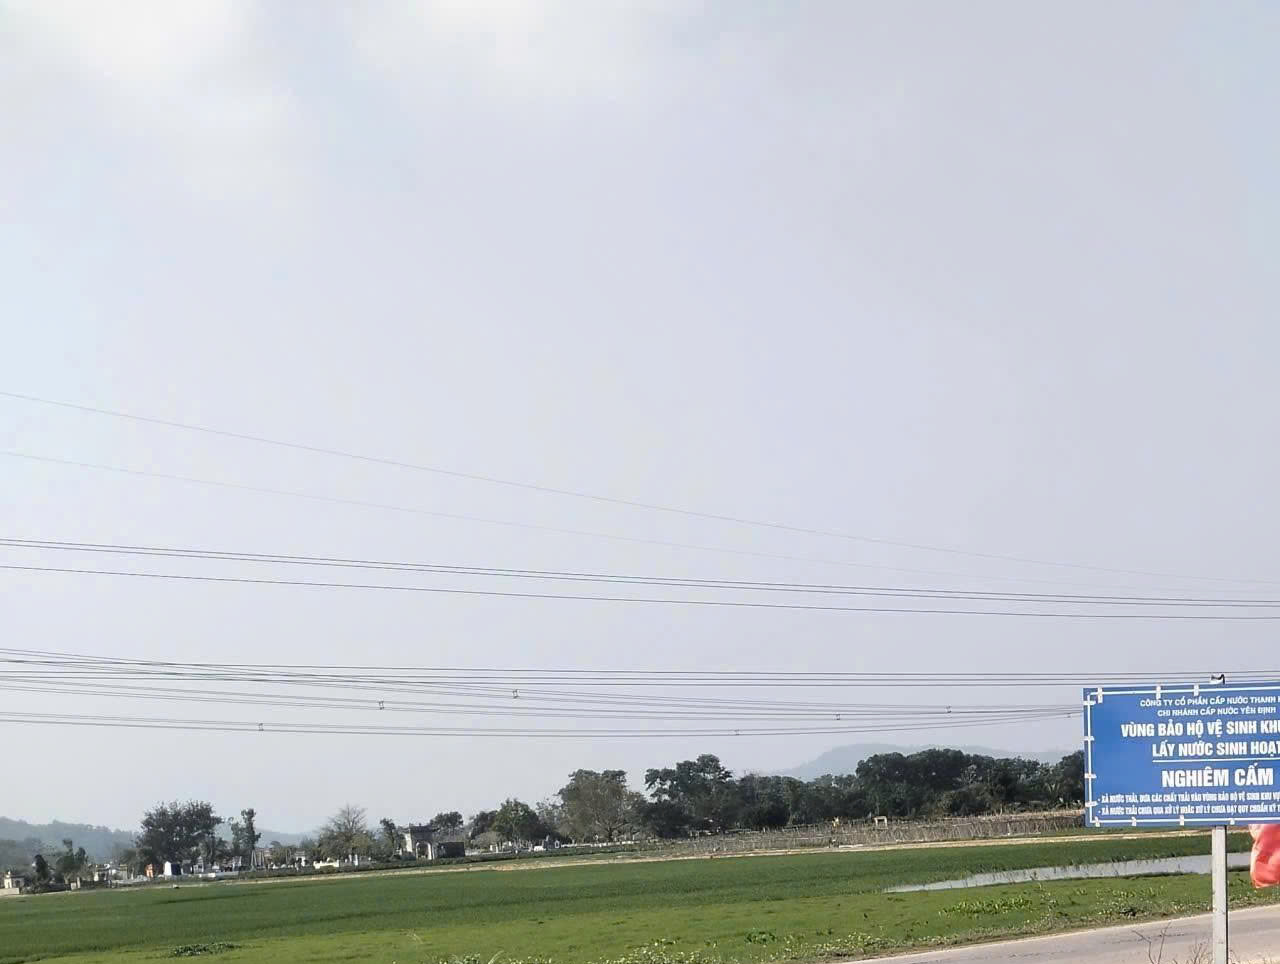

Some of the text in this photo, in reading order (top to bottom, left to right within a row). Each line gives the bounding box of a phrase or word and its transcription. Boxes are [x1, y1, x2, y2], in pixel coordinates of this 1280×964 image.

[1140, 699, 1161, 707] CÔNG
[1210, 696, 1225, 705] CẤP
[1227, 696, 1248, 704] NƯỚC
[1172, 708, 1198, 716] NHÁNH
[1200, 706, 1215, 715] CẤP
[1217, 706, 1238, 715] NƯỚC
[1240, 706, 1255, 714] YÊN
[1258, 707, 1276, 715] ĐỊNH
[1121, 722, 1154, 737] VÙNG
[1158, 719, 1183, 736] BẢO
[1187, 720, 1204, 738] HỘ
[1207, 720, 1222, 738] VỆ
[1227, 720, 1256, 734] SINH
[1152, 740, 1175, 757] LẤY
[1178, 740, 1213, 756] NƯỚC
[1217, 742, 1247, 755] SINH
[1162, 763, 1273, 787] NGHIÊM CẤM
